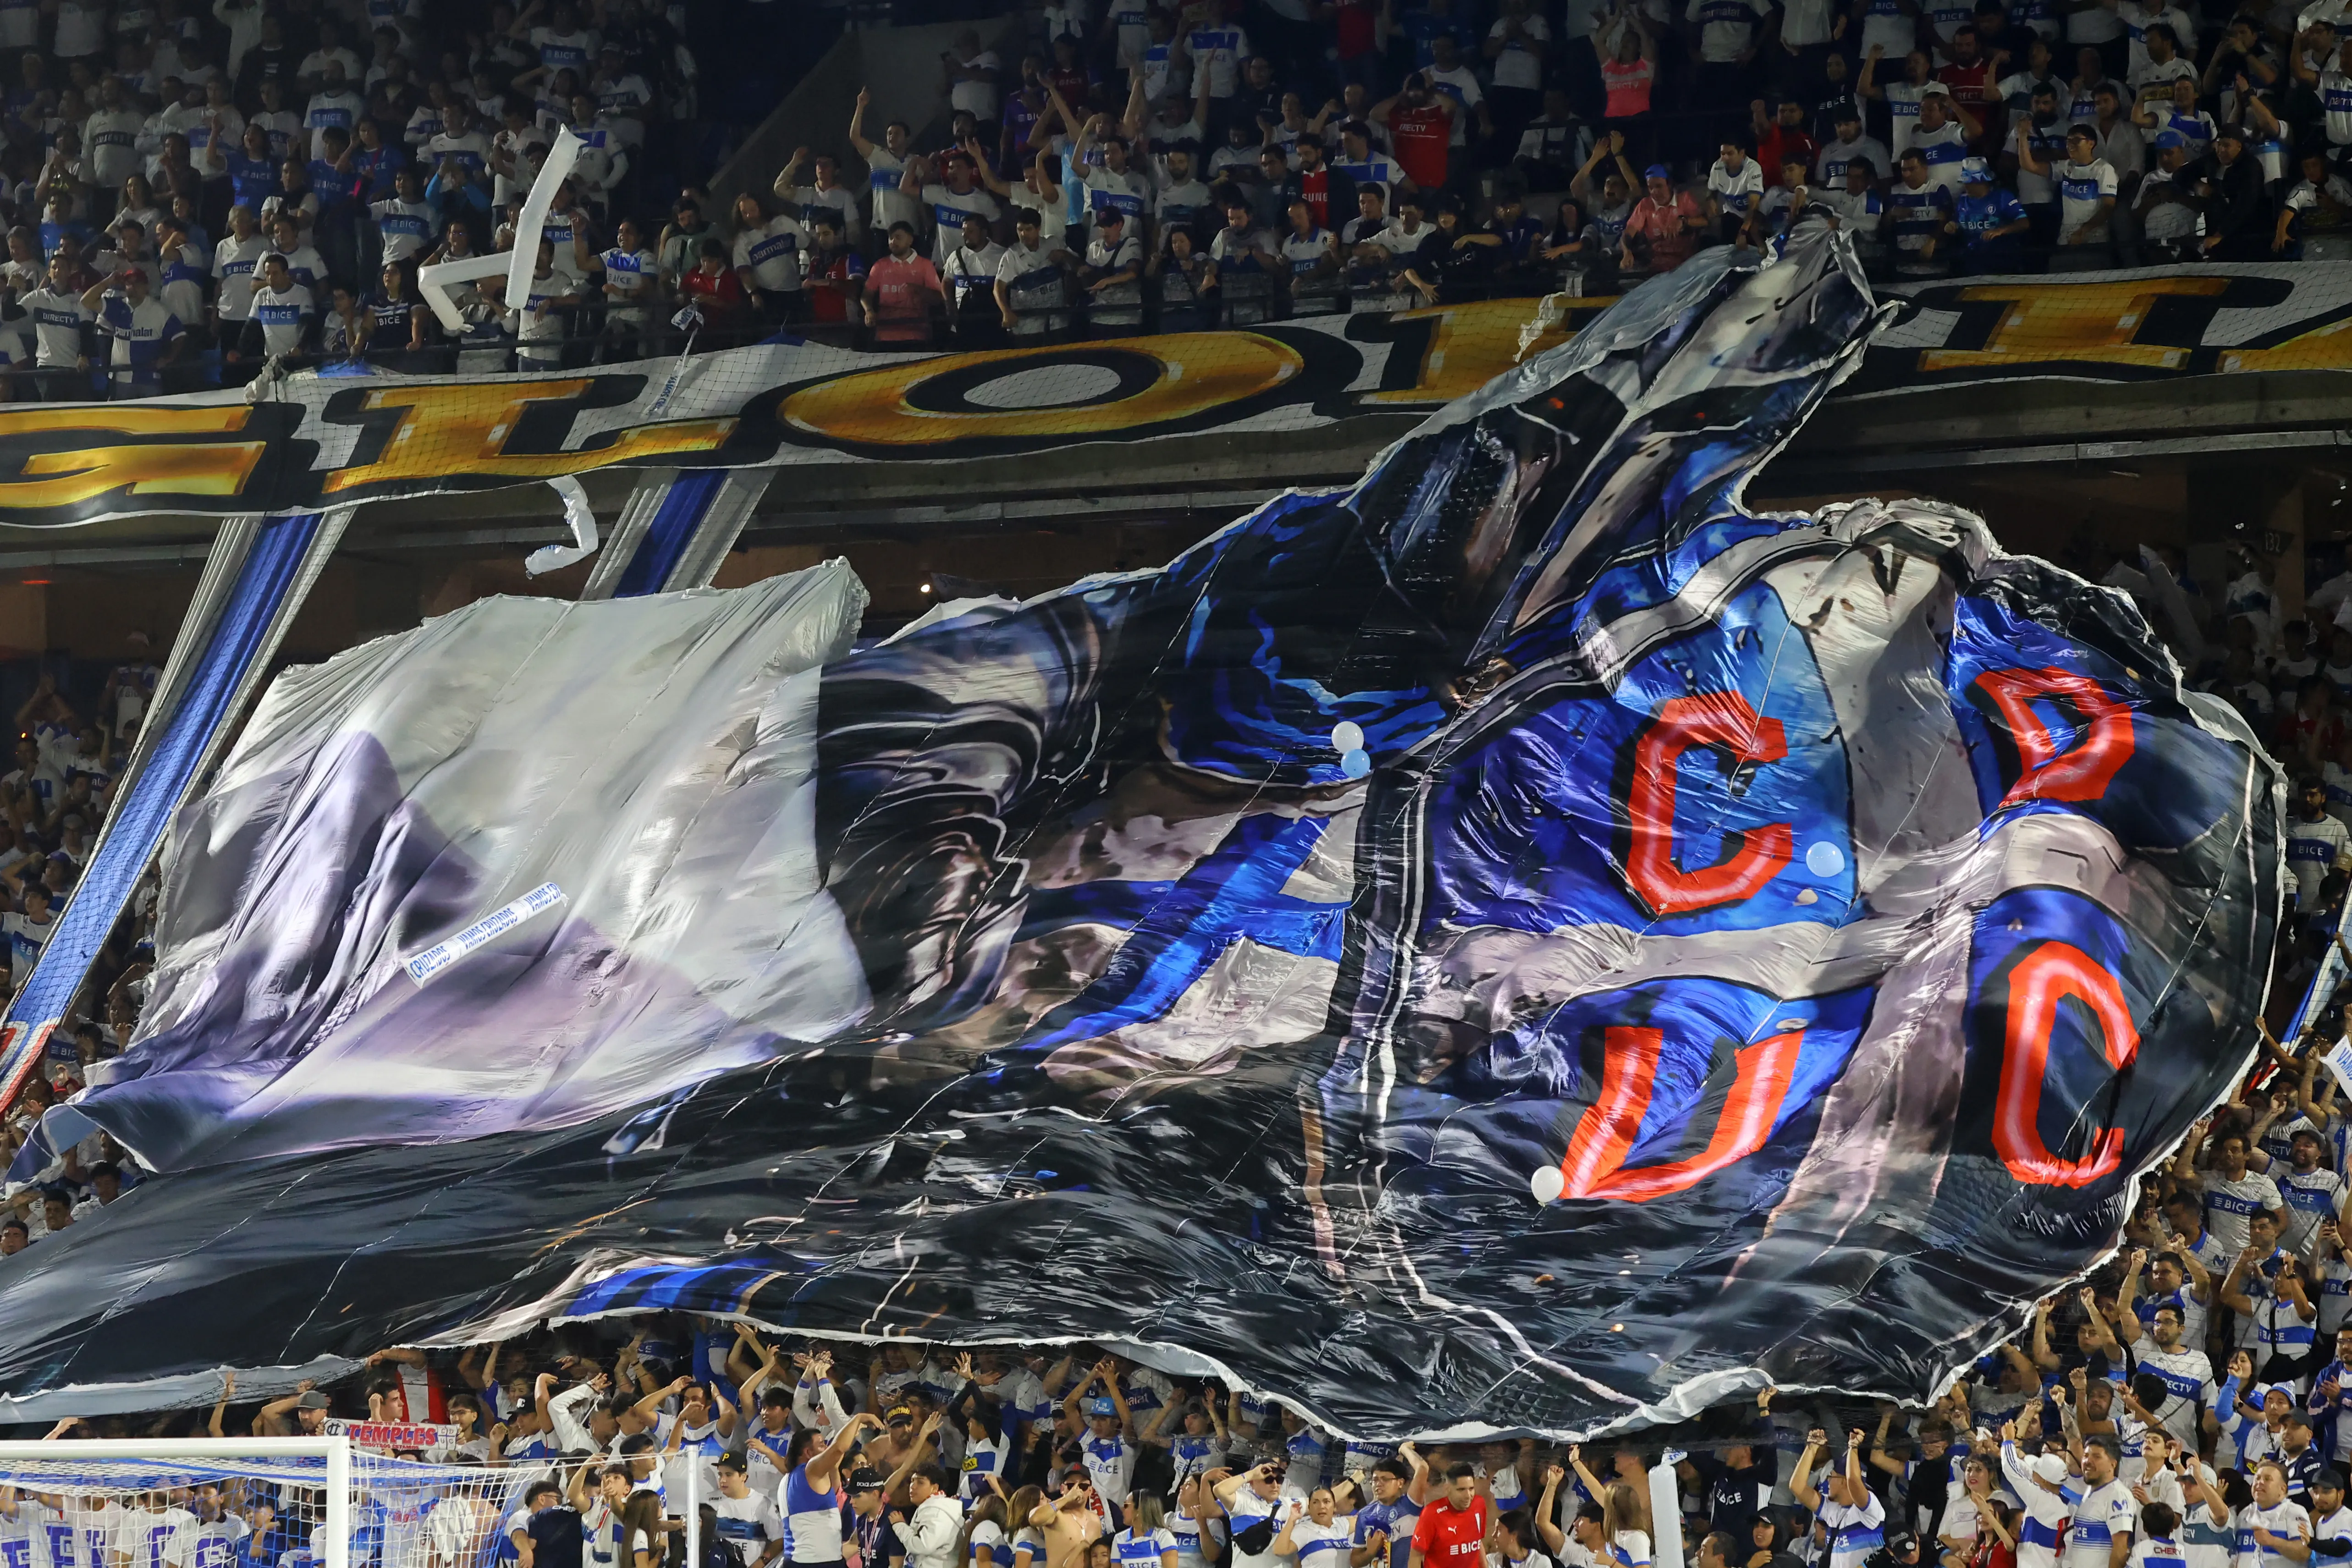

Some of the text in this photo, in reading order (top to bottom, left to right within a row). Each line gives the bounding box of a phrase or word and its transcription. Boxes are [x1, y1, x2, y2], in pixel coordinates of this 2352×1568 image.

[1705, 8, 1741, 18] armalat
[2019, 6, 2042, 16] BCE
[1941, 12, 1965, 21] BICE
[554, 51, 576, 60] BICE
[1903, 105, 1919, 113] BIC
[1926, 150, 1938, 159] CE
[1838, 165, 1847, 174] BI
[2069, 185, 2089, 194] BICE
[1302, 193, 1328, 202] SUNG
[950, 212, 963, 222] BI
[1967, 220, 1990, 231] BICE
[554, 231, 573, 239] BIC
[233, 264, 255, 273] BICE
[43, 313, 75, 324] DIRECTV
[271, 311, 292, 319] BICE
[379, 315, 401, 327] BICE
[2264, 531, 2281, 552] 132
[1626, 666, 2135, 914] C D
[2298, 845, 2324, 857] BICE
[410, 946, 450, 979] CRUZADOS
[458, 925, 486, 950] VAMOS
[479, 907, 518, 938] CRUZADOS
[524, 886, 552, 913] VAMOS
[61, 1047, 78, 1058] BIC
[1559, 941, 2140, 1202] U C
[2269, 1146, 2291, 1156] ECTV
[2224, 1199, 2253, 1214] BICE
[2330, 1285, 2345, 1294] BIC
[2162, 1377, 2192, 1393] RECTV
[348, 1424, 436, 1446] TEMPLES
[1356, 1442, 1392, 1457] DIRECT
[722, 1453, 730, 1462] P
[754, 1453, 773, 1465] BIC
[1097, 1461, 1118, 1474] BICE
[1175, 1537, 1197, 1547] ICE
[1461, 1540, 1482, 1554] BICE
[2154, 1547, 2182, 1556] CHERY
